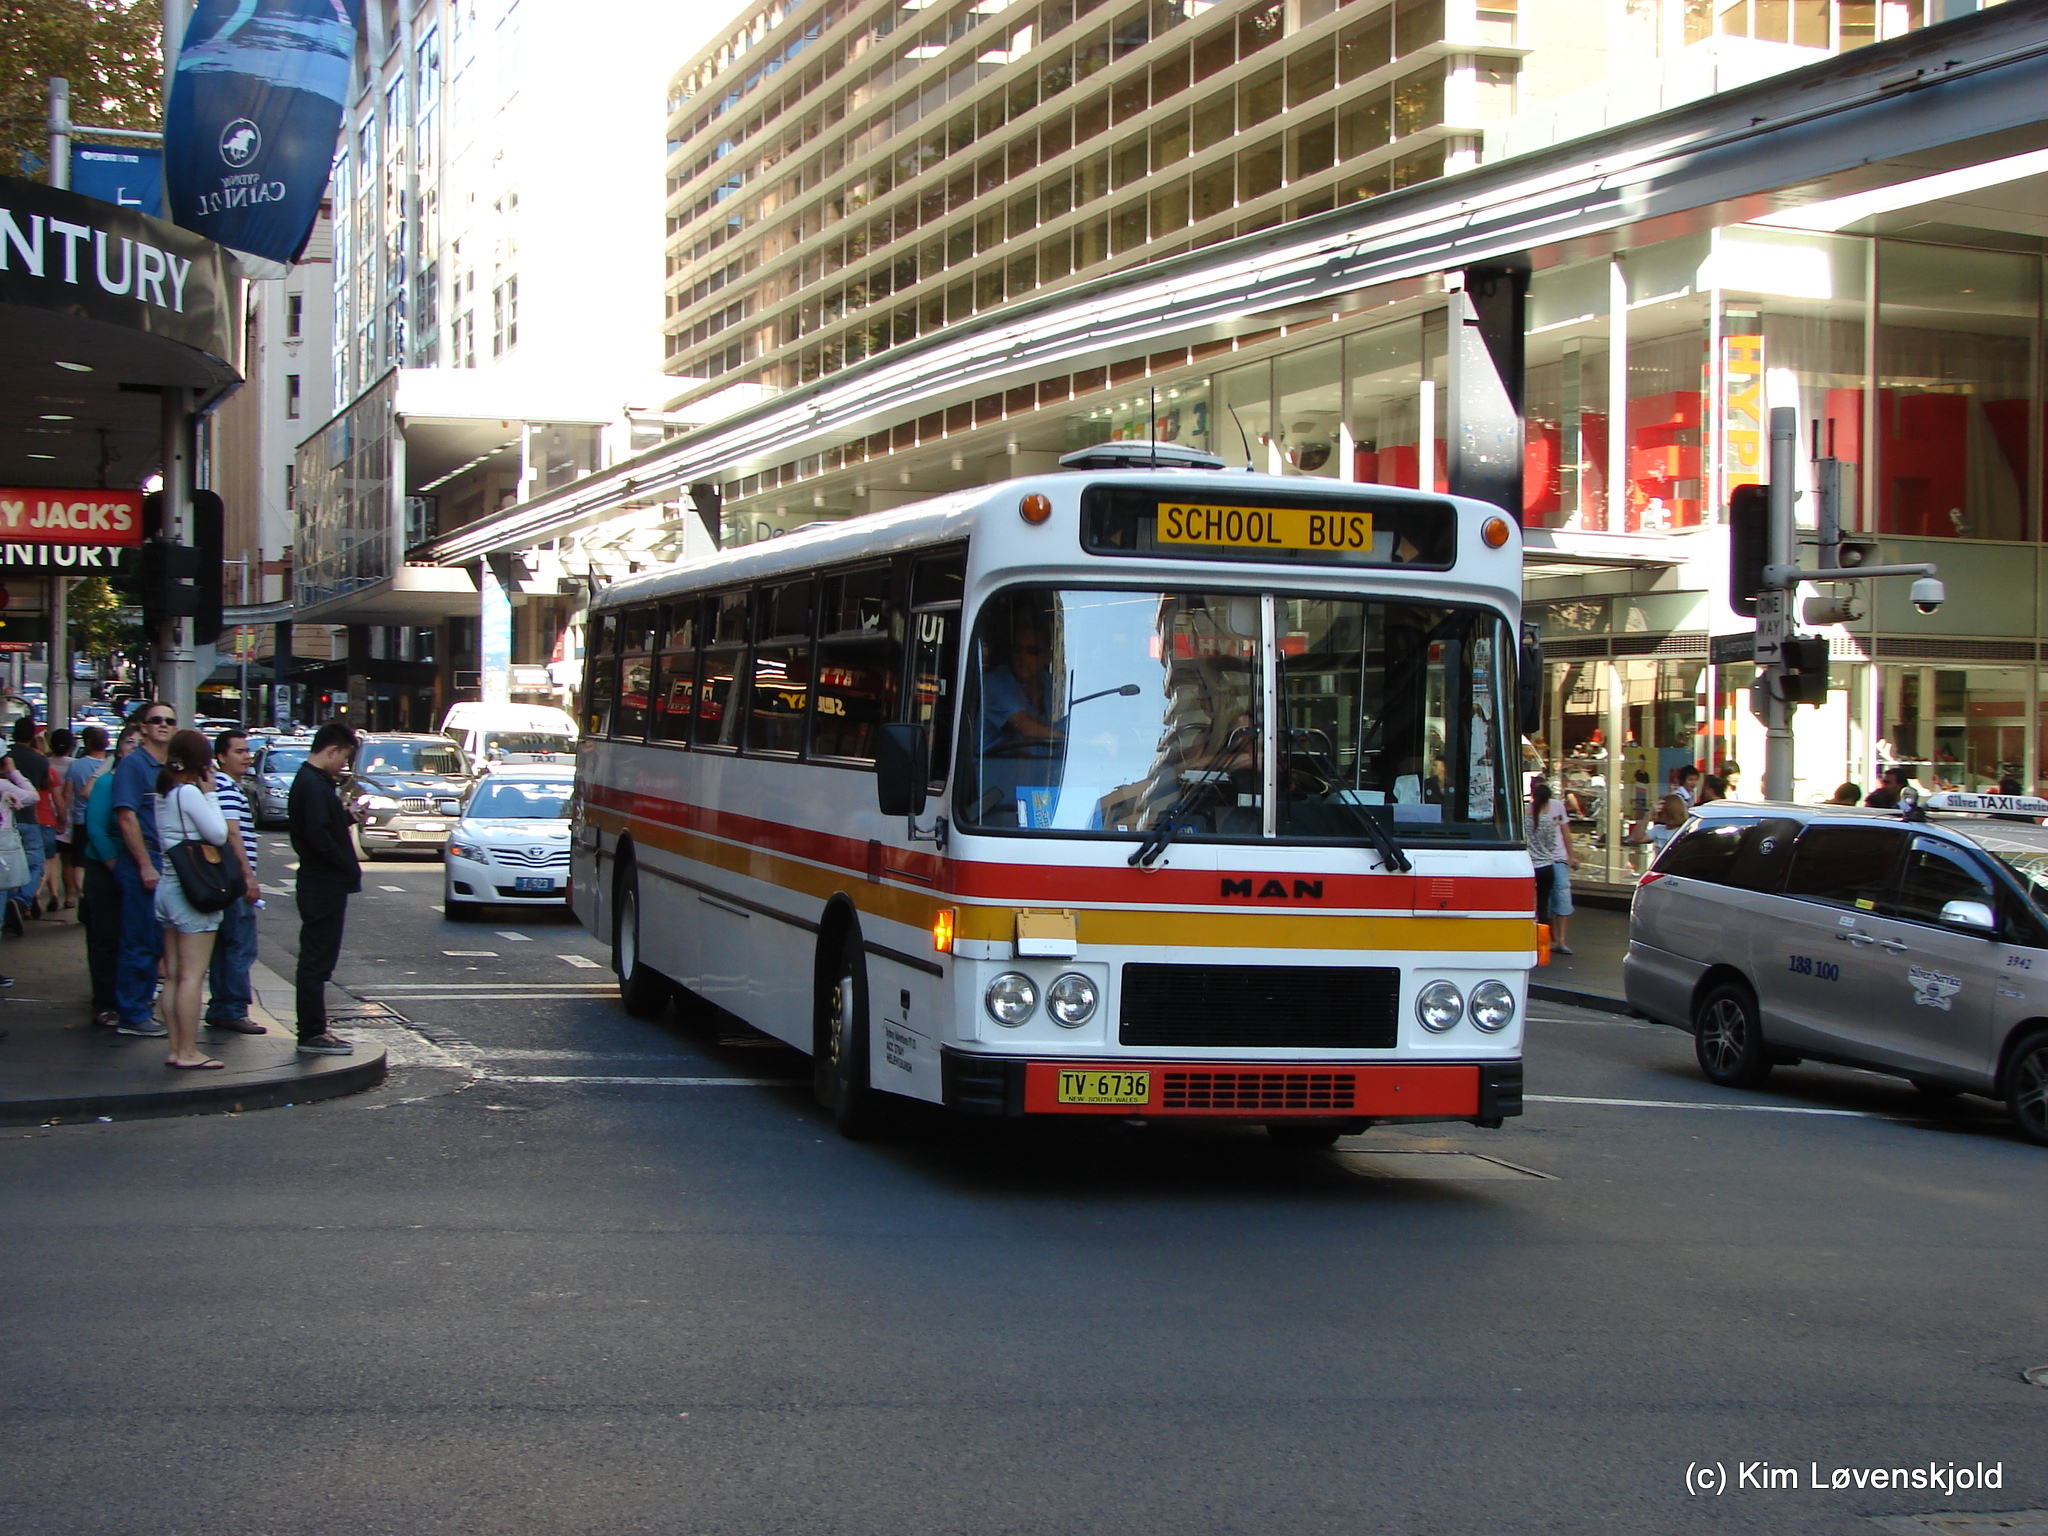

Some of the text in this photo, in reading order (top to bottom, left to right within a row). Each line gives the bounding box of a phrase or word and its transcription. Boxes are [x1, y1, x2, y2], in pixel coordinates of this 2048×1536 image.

[0, 500, 132, 531] Y JACK'S
[1166, 507, 1364, 548] SCHOOL BUS
[0, 544, 123, 567] NTURY
[1759, 596, 1779, 614] ONE
[1758, 620, 1780, 636] WAY
[530, 754, 557, 764] TAXI
[1947, 795, 2048, 812] Silver TAXI Servic
[1221, 878, 1323, 898] MAN
[1789, 954, 1839, 982] 133 100
[1062, 1074, 1146, 1096] TV-6736
